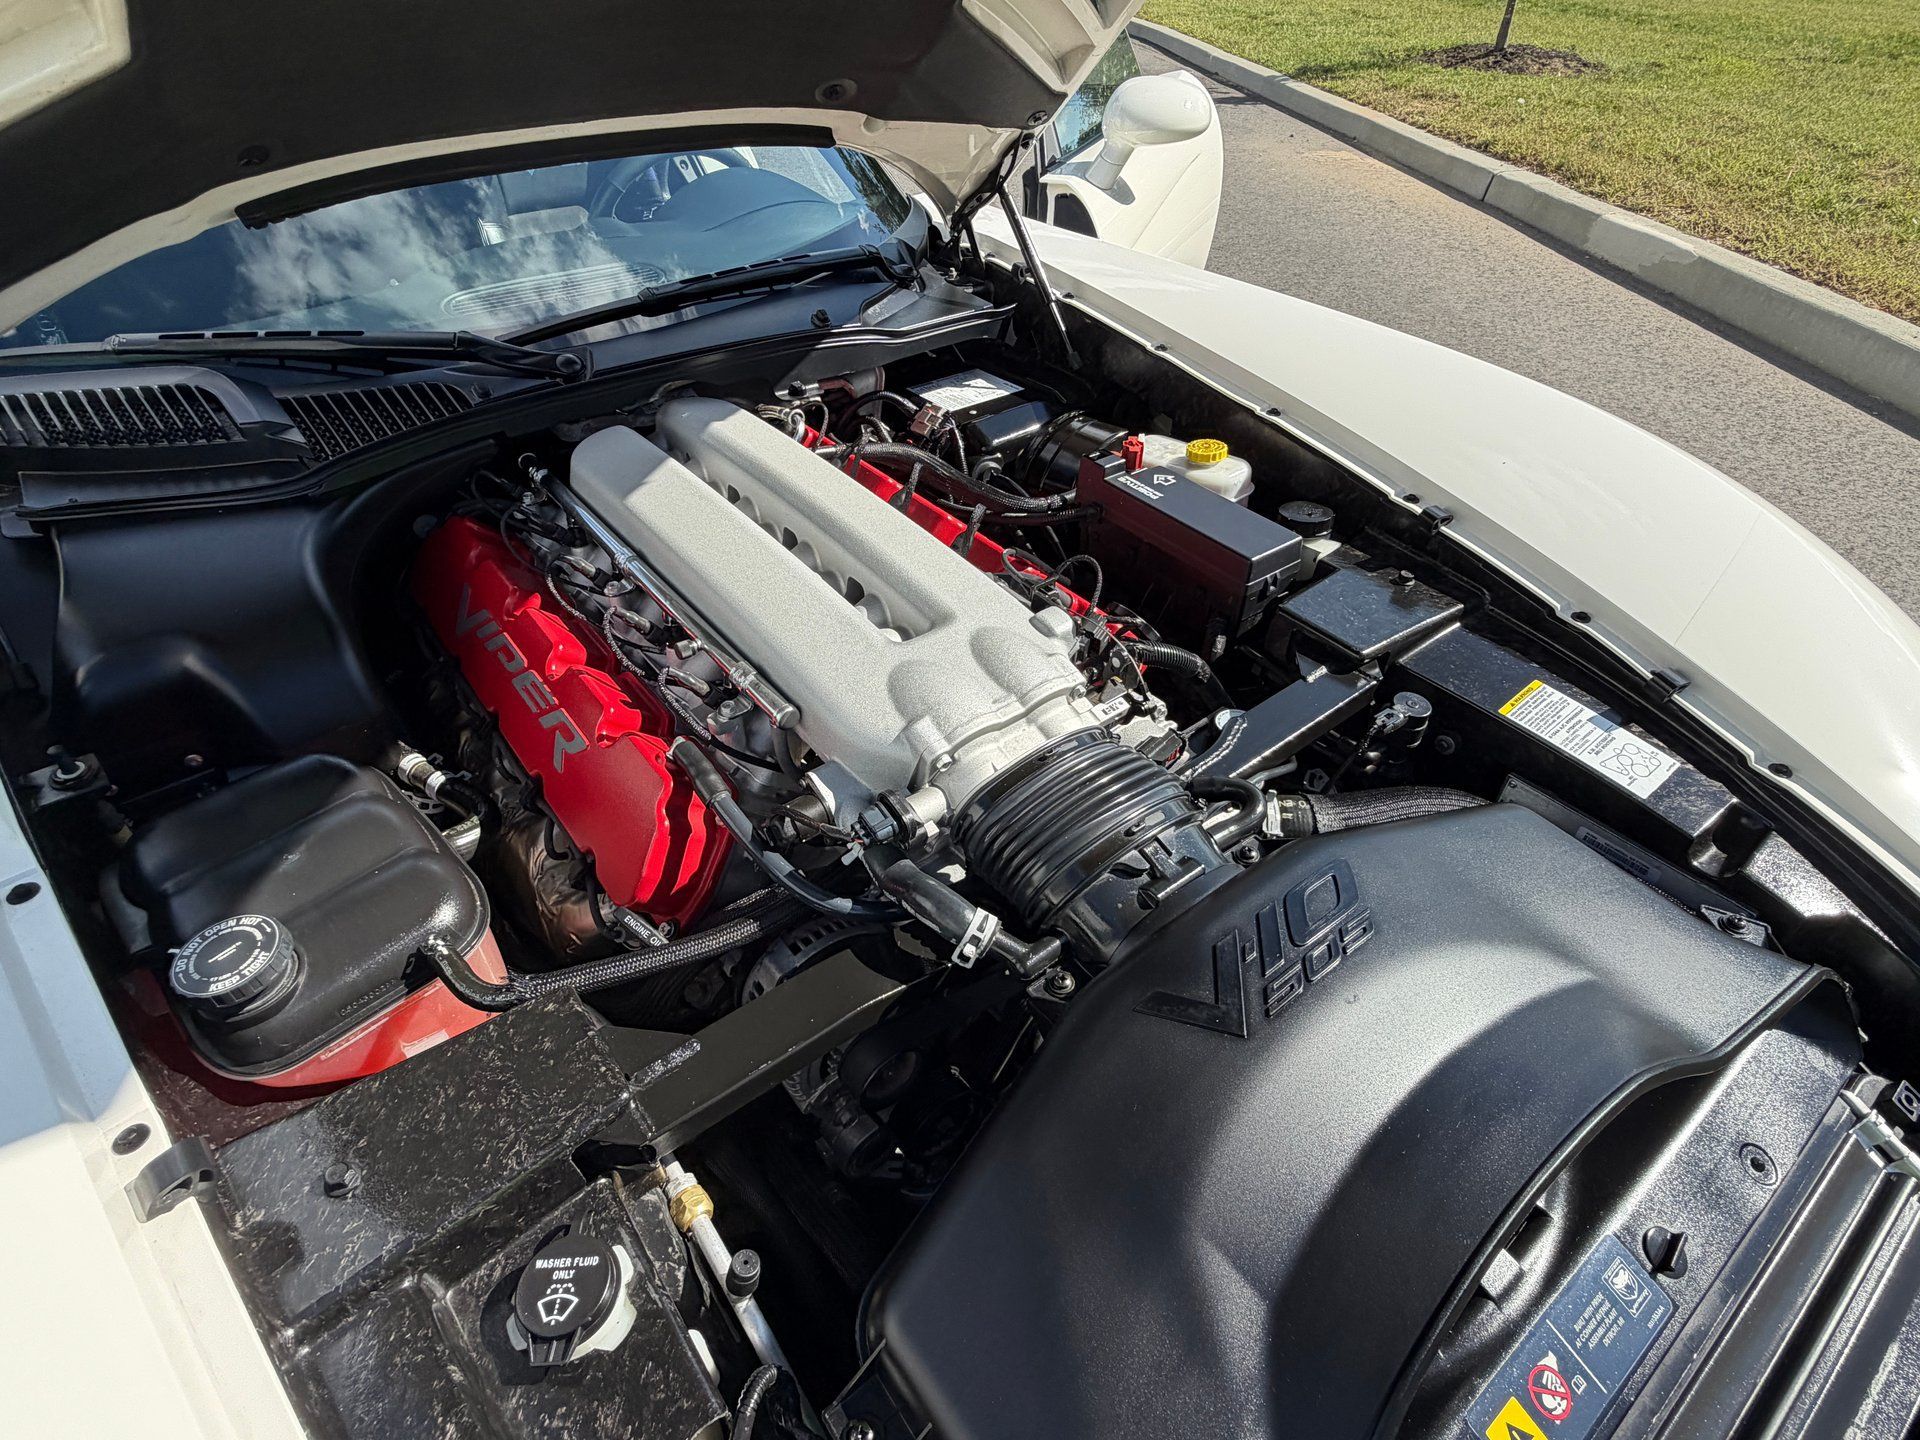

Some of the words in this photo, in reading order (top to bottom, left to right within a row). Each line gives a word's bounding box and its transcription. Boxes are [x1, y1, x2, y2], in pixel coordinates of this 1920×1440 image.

[456, 581, 591, 774] VIPER
[175, 957, 188, 973] DO
[182, 937, 203, 956] NOT
[204, 918, 237, 937] OPEN
[239, 916, 263, 926] HOT
[623, 915, 651, 939] ENGINE
[208, 974, 241, 992] KEEP
[241, 950, 270, 976] TIGHT
[1263, 907, 1375, 1018] 505
[535, 1257, 572, 1269] WASHER
[573, 1255, 600, 1267] FLUID
[552, 1269, 576, 1280] ONLY
